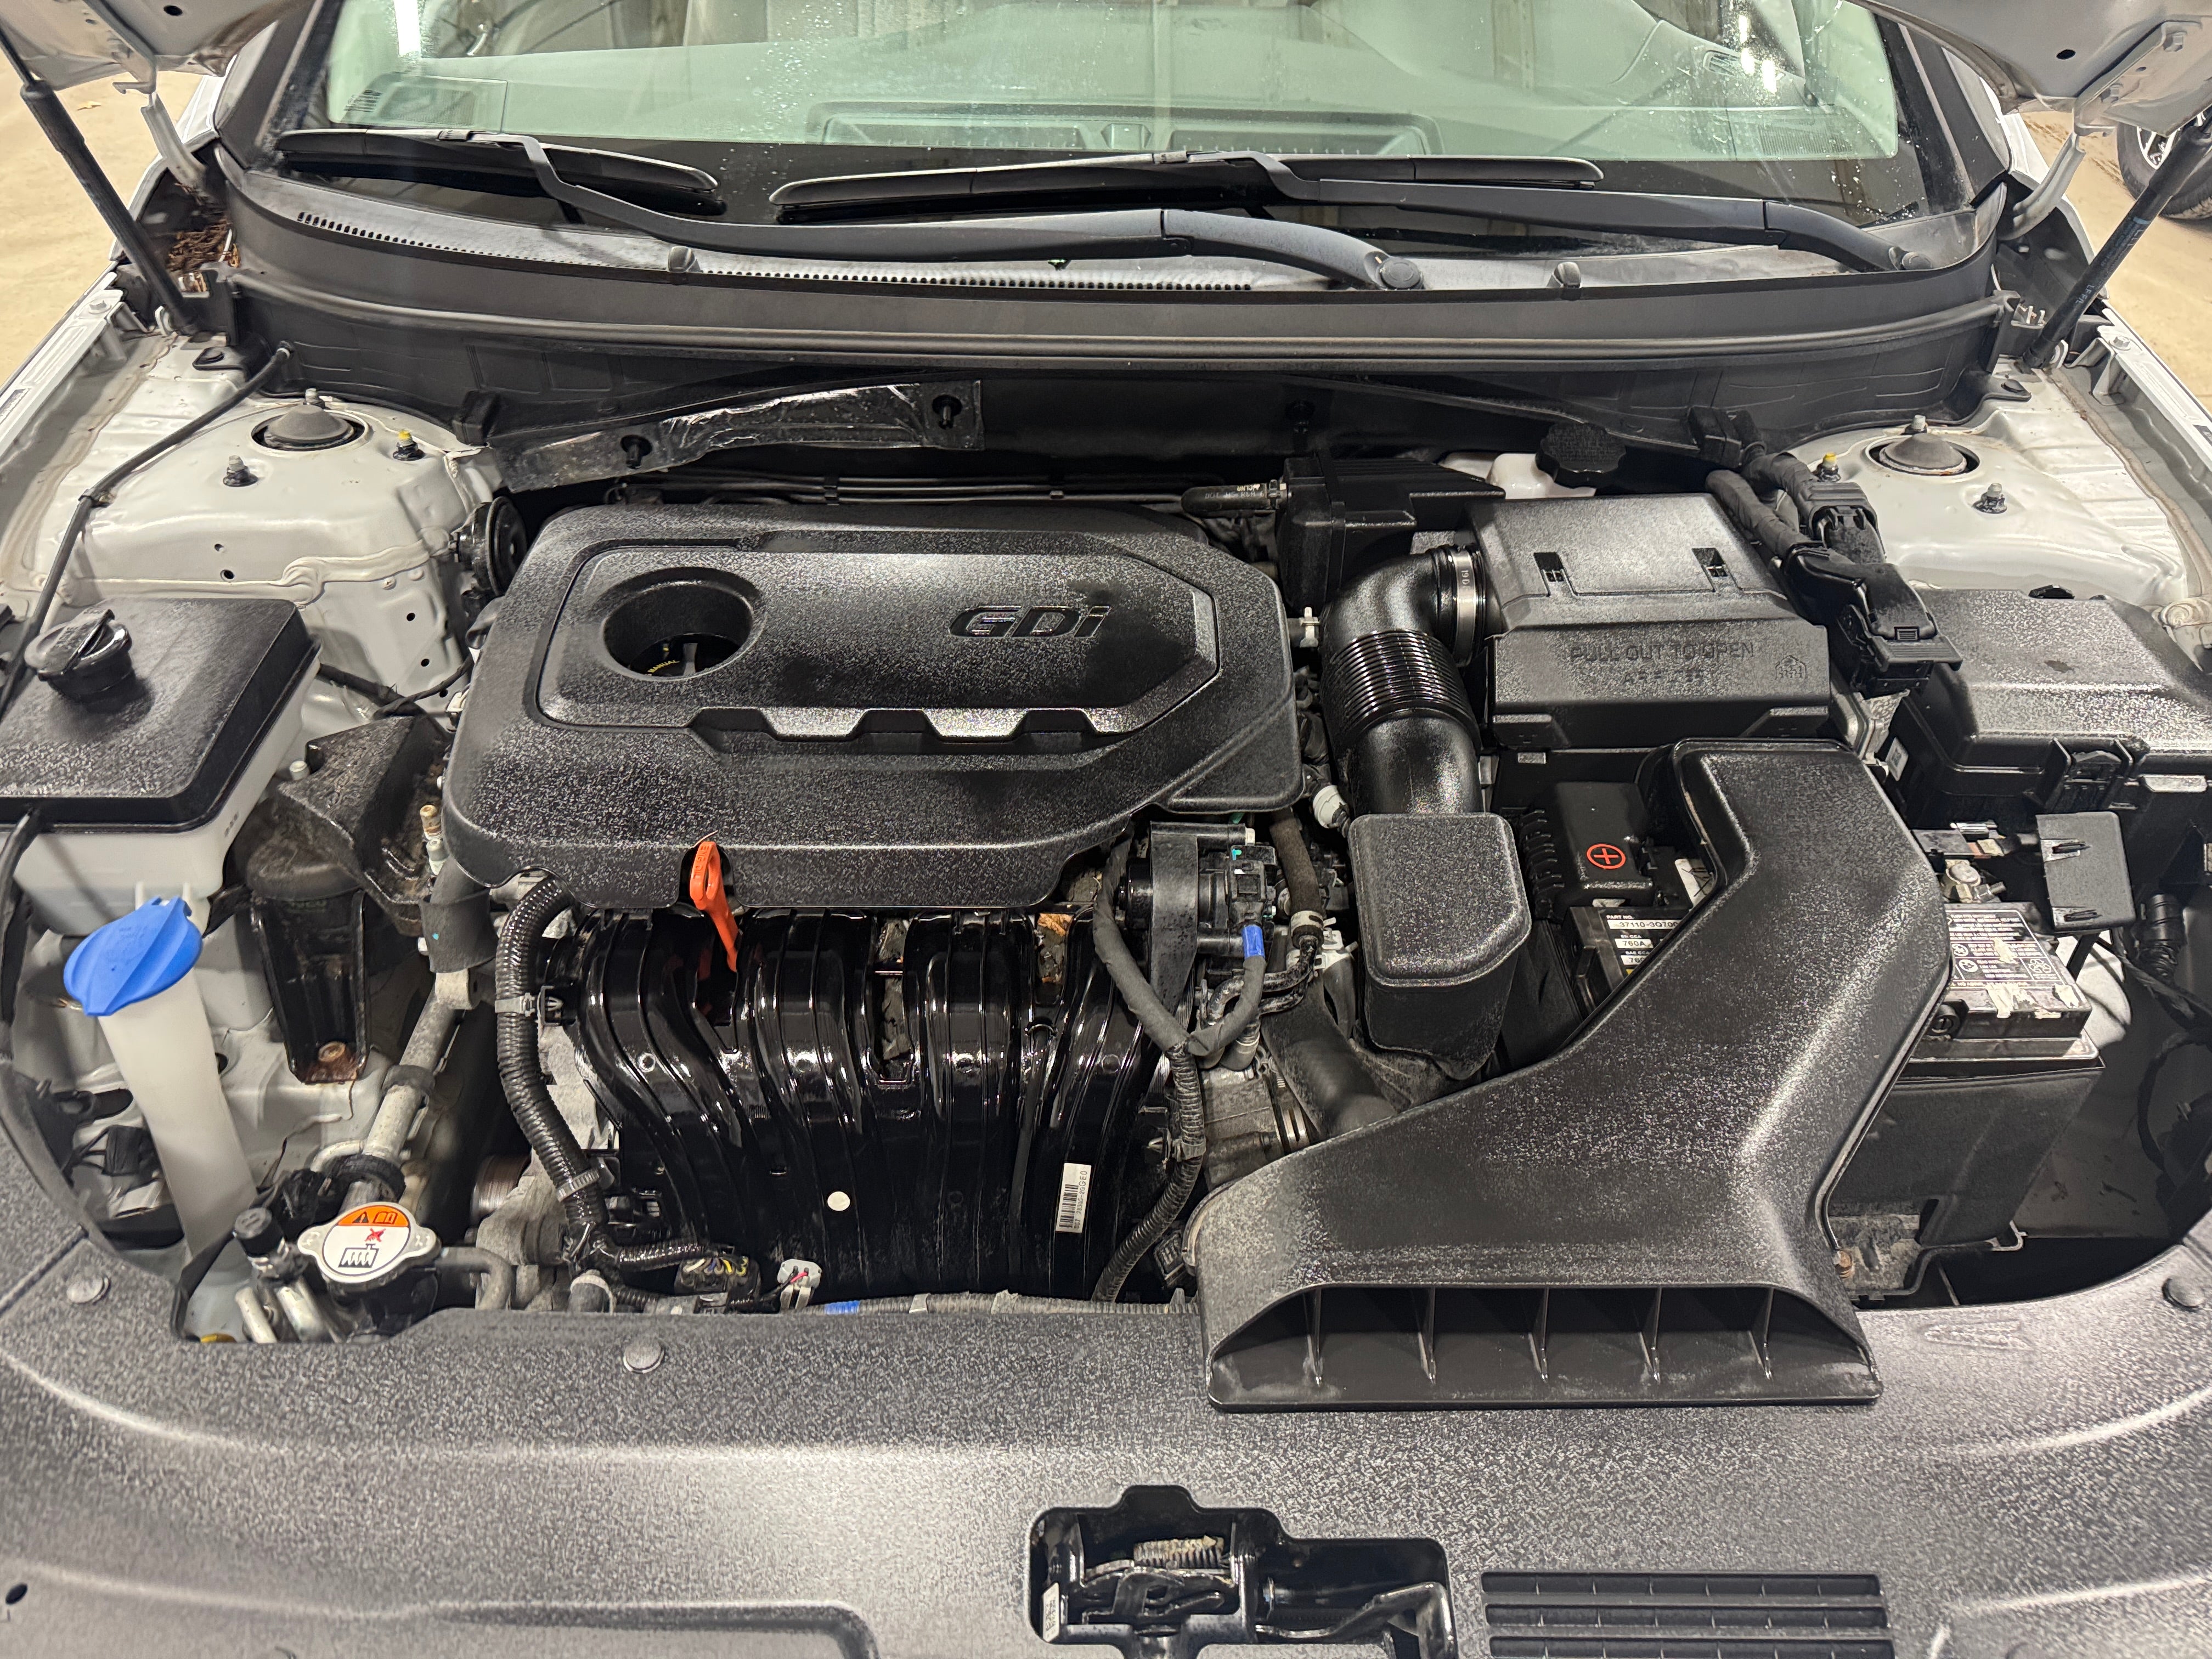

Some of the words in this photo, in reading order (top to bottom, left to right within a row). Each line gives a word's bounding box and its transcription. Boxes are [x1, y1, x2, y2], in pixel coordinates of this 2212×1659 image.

[948, 605, 1112, 638] GDi
[1570, 645, 1620, 661] PULL
[1626, 644, 1664, 660] OUT
[1671, 643, 1695, 660] TO
[1701, 641, 1754, 659] OPEN
